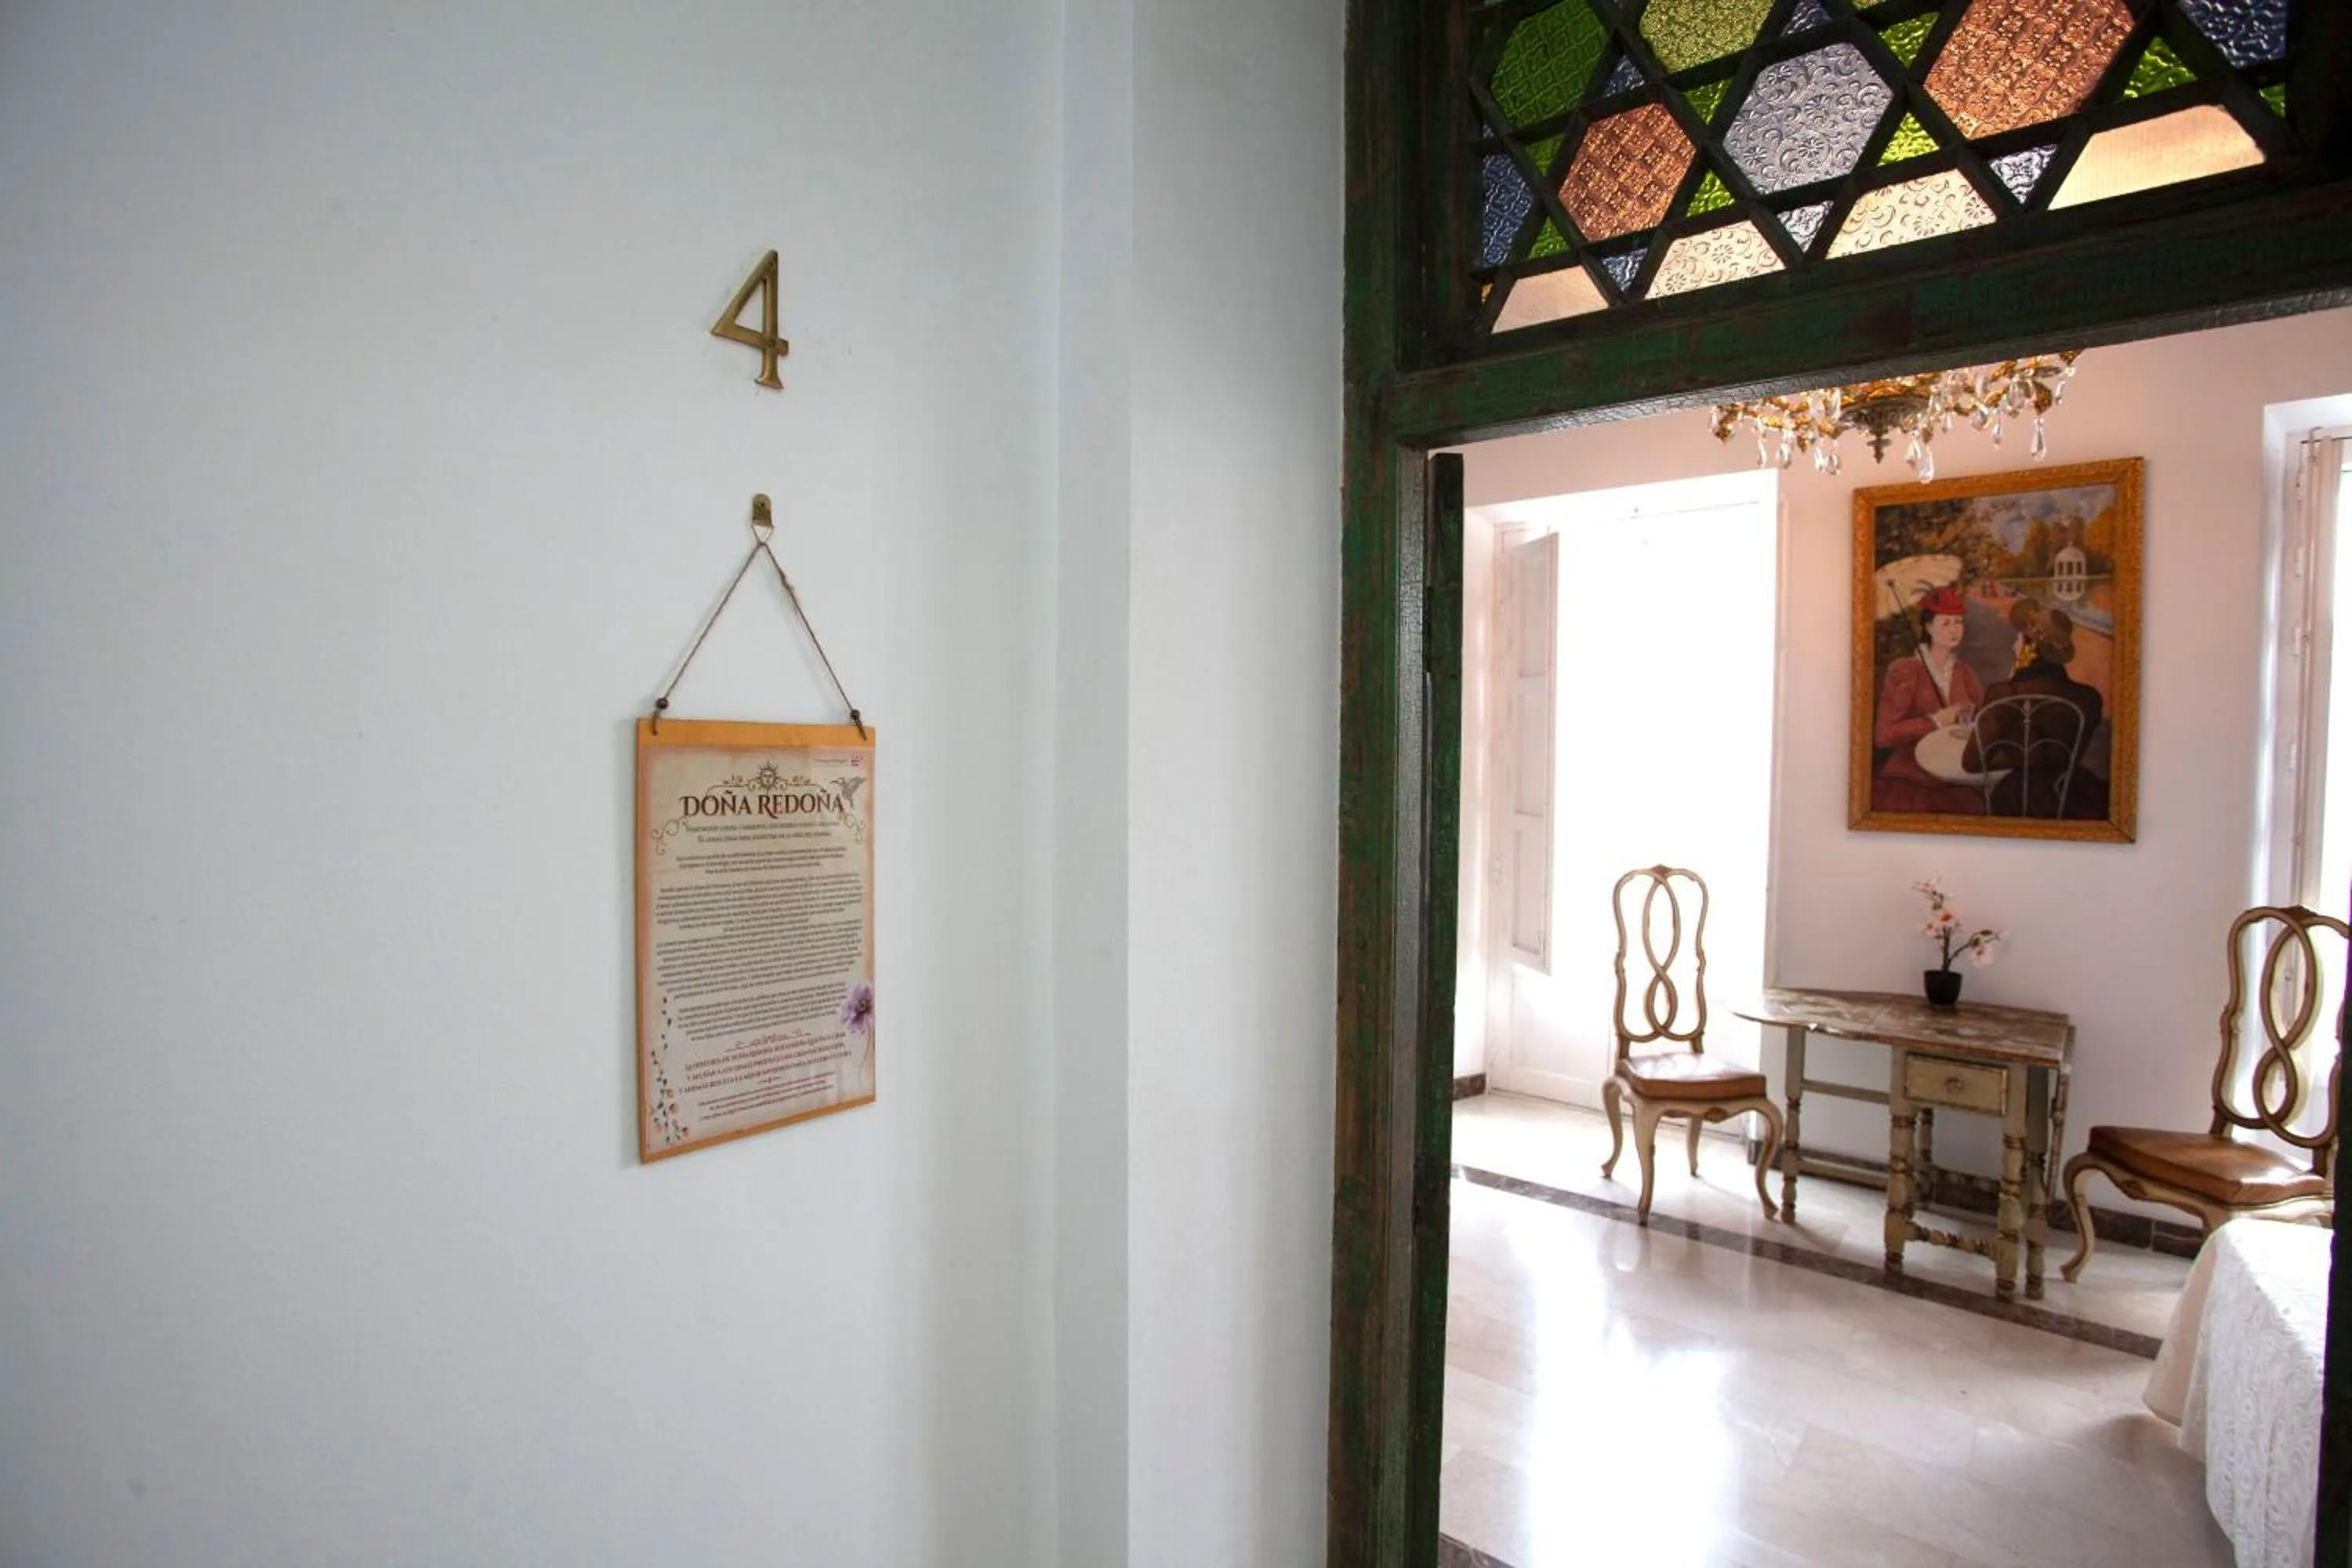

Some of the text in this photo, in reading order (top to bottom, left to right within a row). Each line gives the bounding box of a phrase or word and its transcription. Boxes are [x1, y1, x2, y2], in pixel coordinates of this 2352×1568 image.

[710, 249, 789, 389] 4
[679, 788, 846, 818] DOÑA REDOÑA
